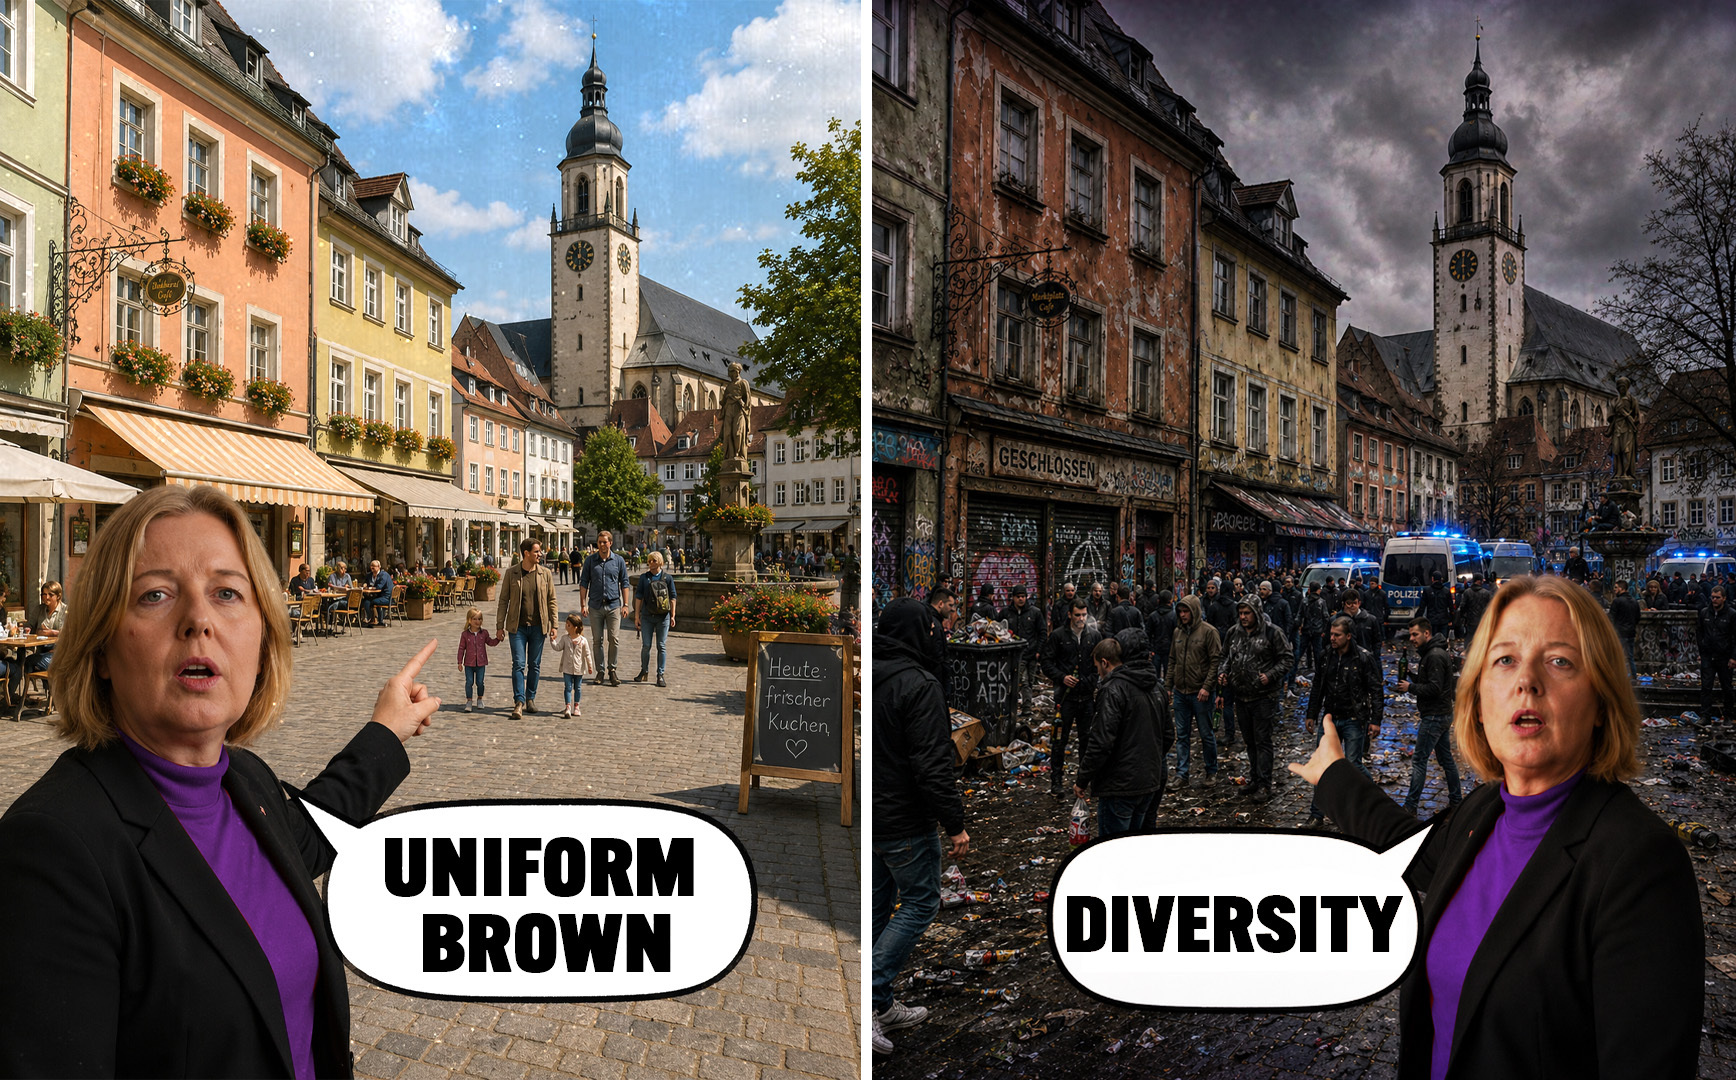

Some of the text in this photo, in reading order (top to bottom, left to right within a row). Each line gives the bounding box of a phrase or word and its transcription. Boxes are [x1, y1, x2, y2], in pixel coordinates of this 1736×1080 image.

[999, 446, 1096, 481] GESCHLOSSEN
[769, 657, 827, 679] Heute:
[765, 685, 831, 708] frischer
[976, 682, 1007, 703] AFD
